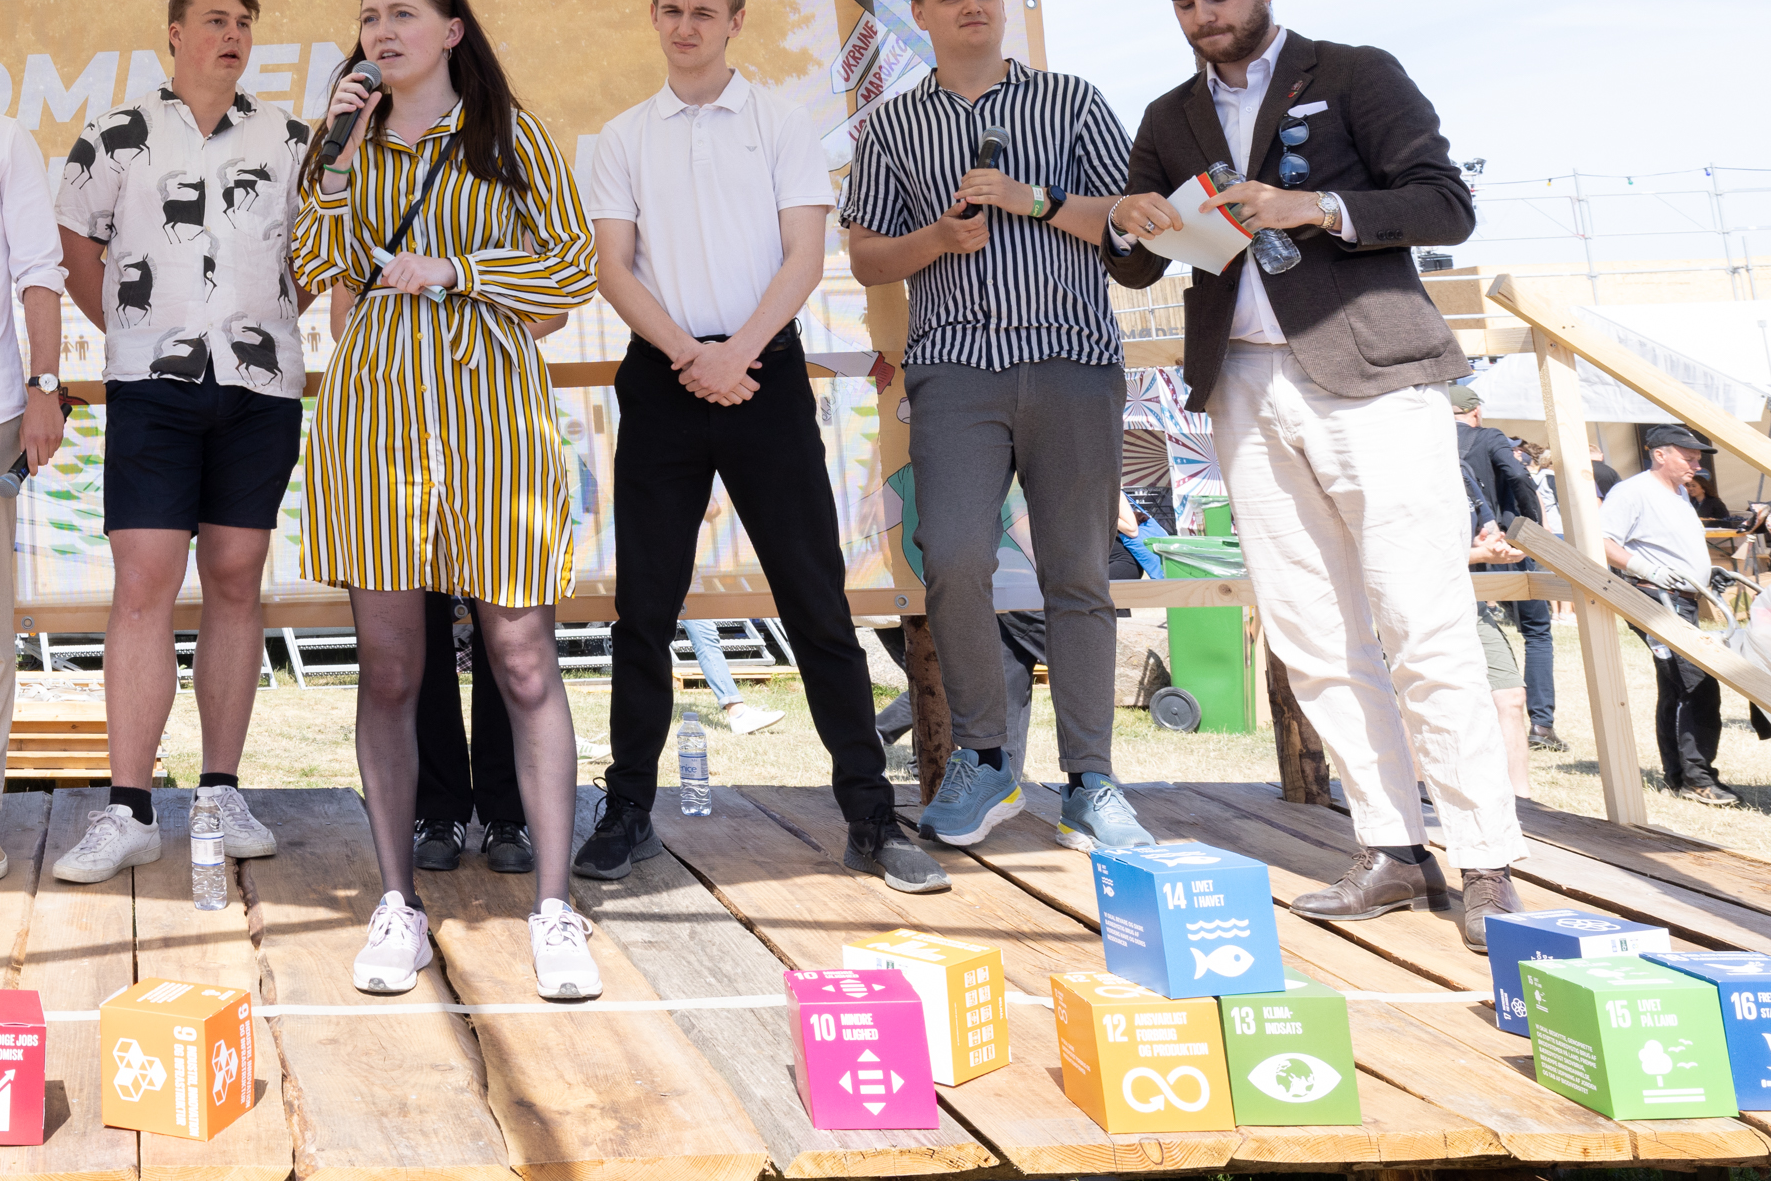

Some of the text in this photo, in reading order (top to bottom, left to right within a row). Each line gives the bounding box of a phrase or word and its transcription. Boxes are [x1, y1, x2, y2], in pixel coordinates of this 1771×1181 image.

[836, 20, 878, 83] UKRAINE
[860, 36, 908, 104] MAROKKO
[1120, 326, 1185, 339] MØDE
[1163, 880, 1213, 910] 14 LIVET
[1193, 894, 1224, 908] I HAVET
[1605, 999, 1661, 1028] 15 LIVET
[1731, 992, 1757, 1020] 16
[810, 1013, 874, 1041] 10 MINDRE
[1103, 1012, 1187, 1043] 12 ANSVARLIGT
[1230, 1006, 1293, 1035] 13 KLIMA-
[1265, 1022, 1303, 1035] INDSATS
[1641, 1013, 1678, 1027] PÅ LAND
[16, 1035, 38, 1047] JOBS
[173, 1025, 197, 1042] 9
[842, 1028, 879, 1041] ULIGHED
[1136, 1028, 1177, 1042] FORBRUG
[1138, 1042, 1209, 1057] OG PRODUKTION
[174, 1057, 186, 1126] INFRASTRUKTUR
